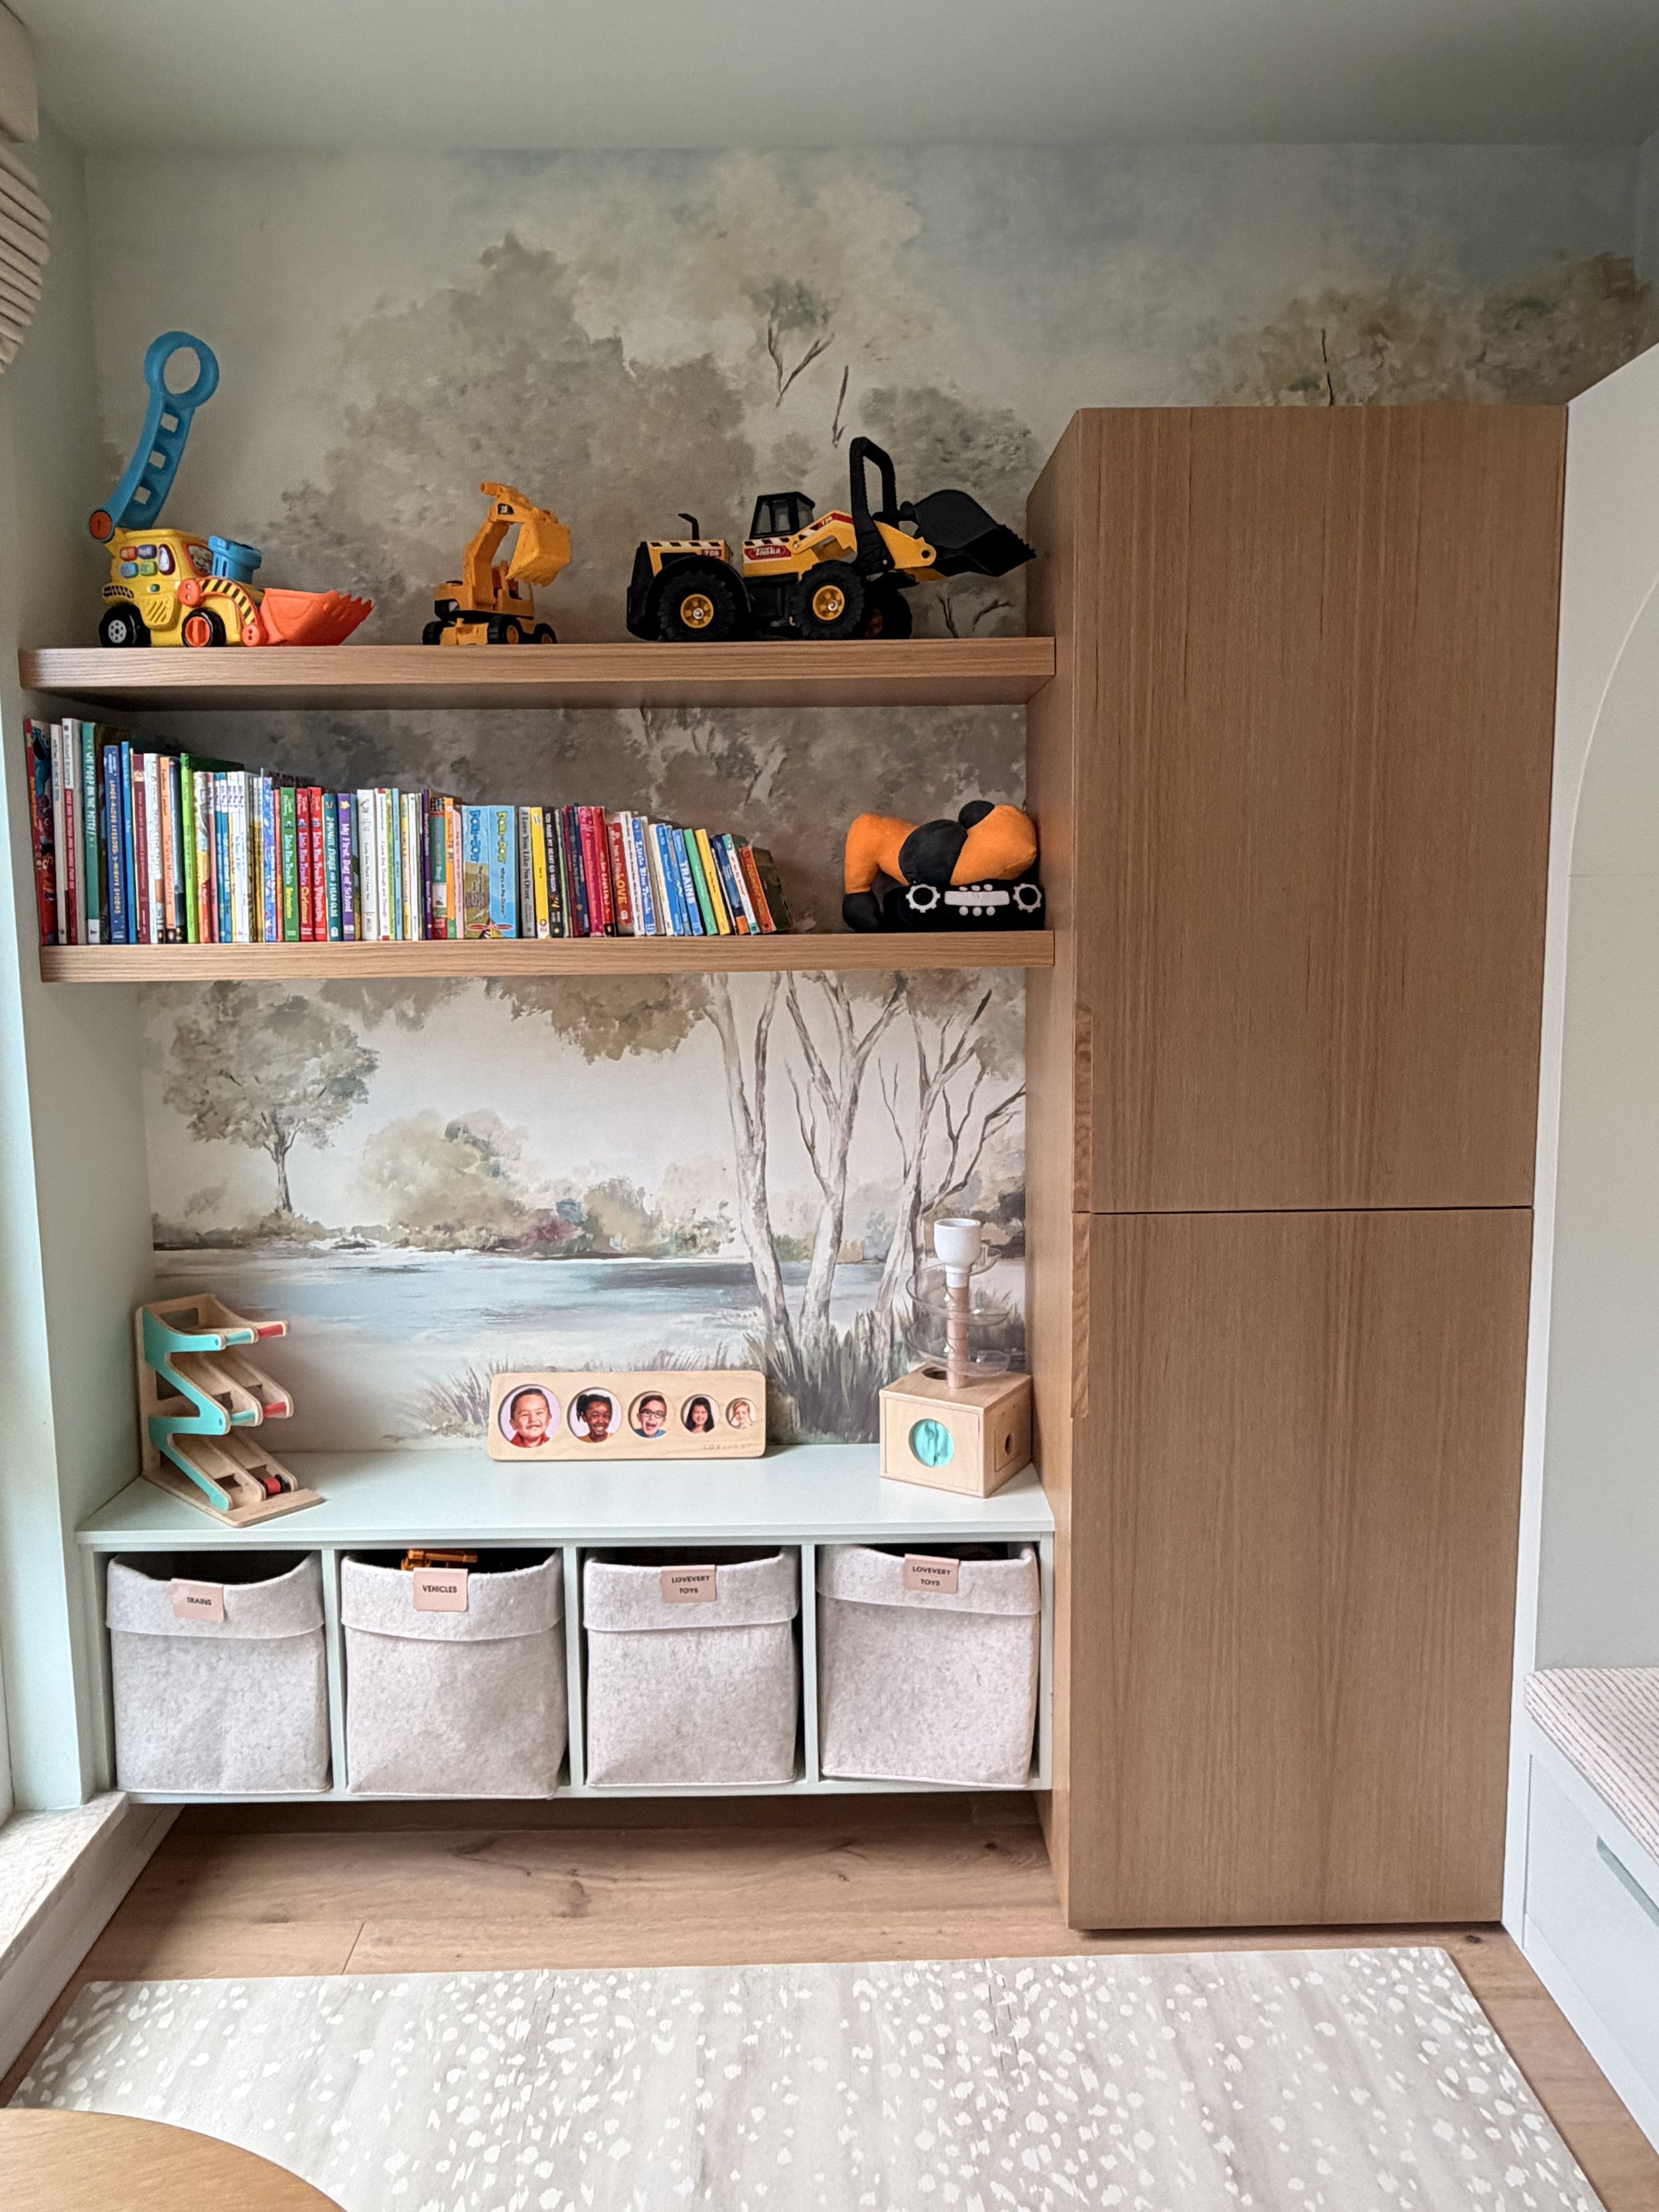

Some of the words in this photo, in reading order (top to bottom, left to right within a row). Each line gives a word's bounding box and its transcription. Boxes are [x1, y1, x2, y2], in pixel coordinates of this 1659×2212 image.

[755, 547, 780, 555] Tonka
[340, 823, 349, 835] My
[342, 838, 351, 857] First
[341, 859, 351, 874] Day
[524, 868, 531, 879] No
[344, 876, 352, 885] of
[344, 887, 353, 913] School
[641, 887, 650, 914] Truck
[912, 1566, 951, 1575] LOVEVERY
[423, 1585, 457, 1593] VEHICLES
[186, 1597, 212, 1605] TRAINS
